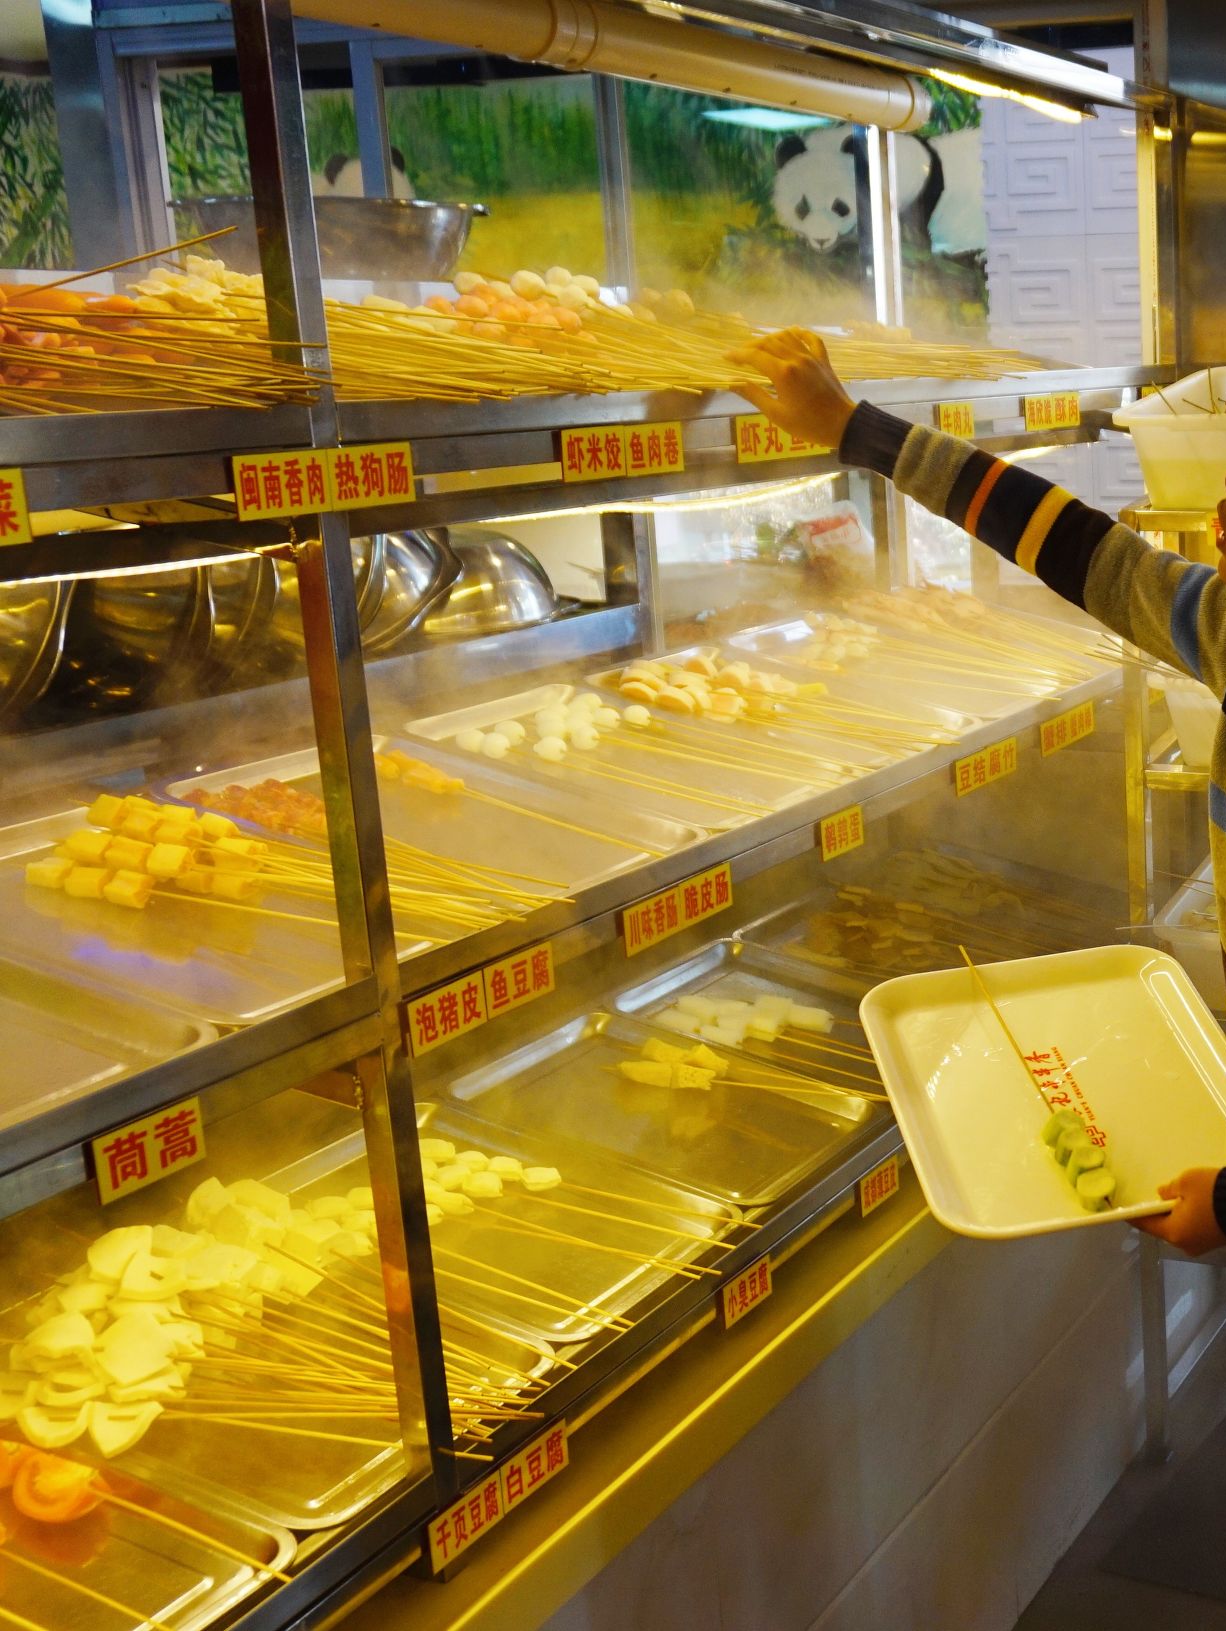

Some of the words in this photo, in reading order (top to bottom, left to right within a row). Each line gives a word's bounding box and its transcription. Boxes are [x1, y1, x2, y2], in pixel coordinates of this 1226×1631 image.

[741, 421, 784, 456] 虾丸
[943, 405, 972, 435] 牛肉丸
[566, 432, 622, 474] 虾米饺
[629, 427, 679, 469] 鱼肉卷
[239, 456, 326, 511] 闽南香肉
[334, 451, 410, 501] 热狗肠
[958, 755, 986, 792] 豆结
[989, 743, 1015, 777] 腐竹
[629, 893, 678, 948] 川味香肠
[684, 870, 729, 920] 脆皮肠
[415, 981, 482, 1046] 泡猪皮
[490, 949, 550, 1010] 鱼豆腐
[103, 1109, 197, 1191] 茼蒿
[728, 1262, 769, 1318] 小臭豆腐
[436, 1481, 499, 1559] 千页豆腐
[506, 1429, 564, 1504] 白豆腐
